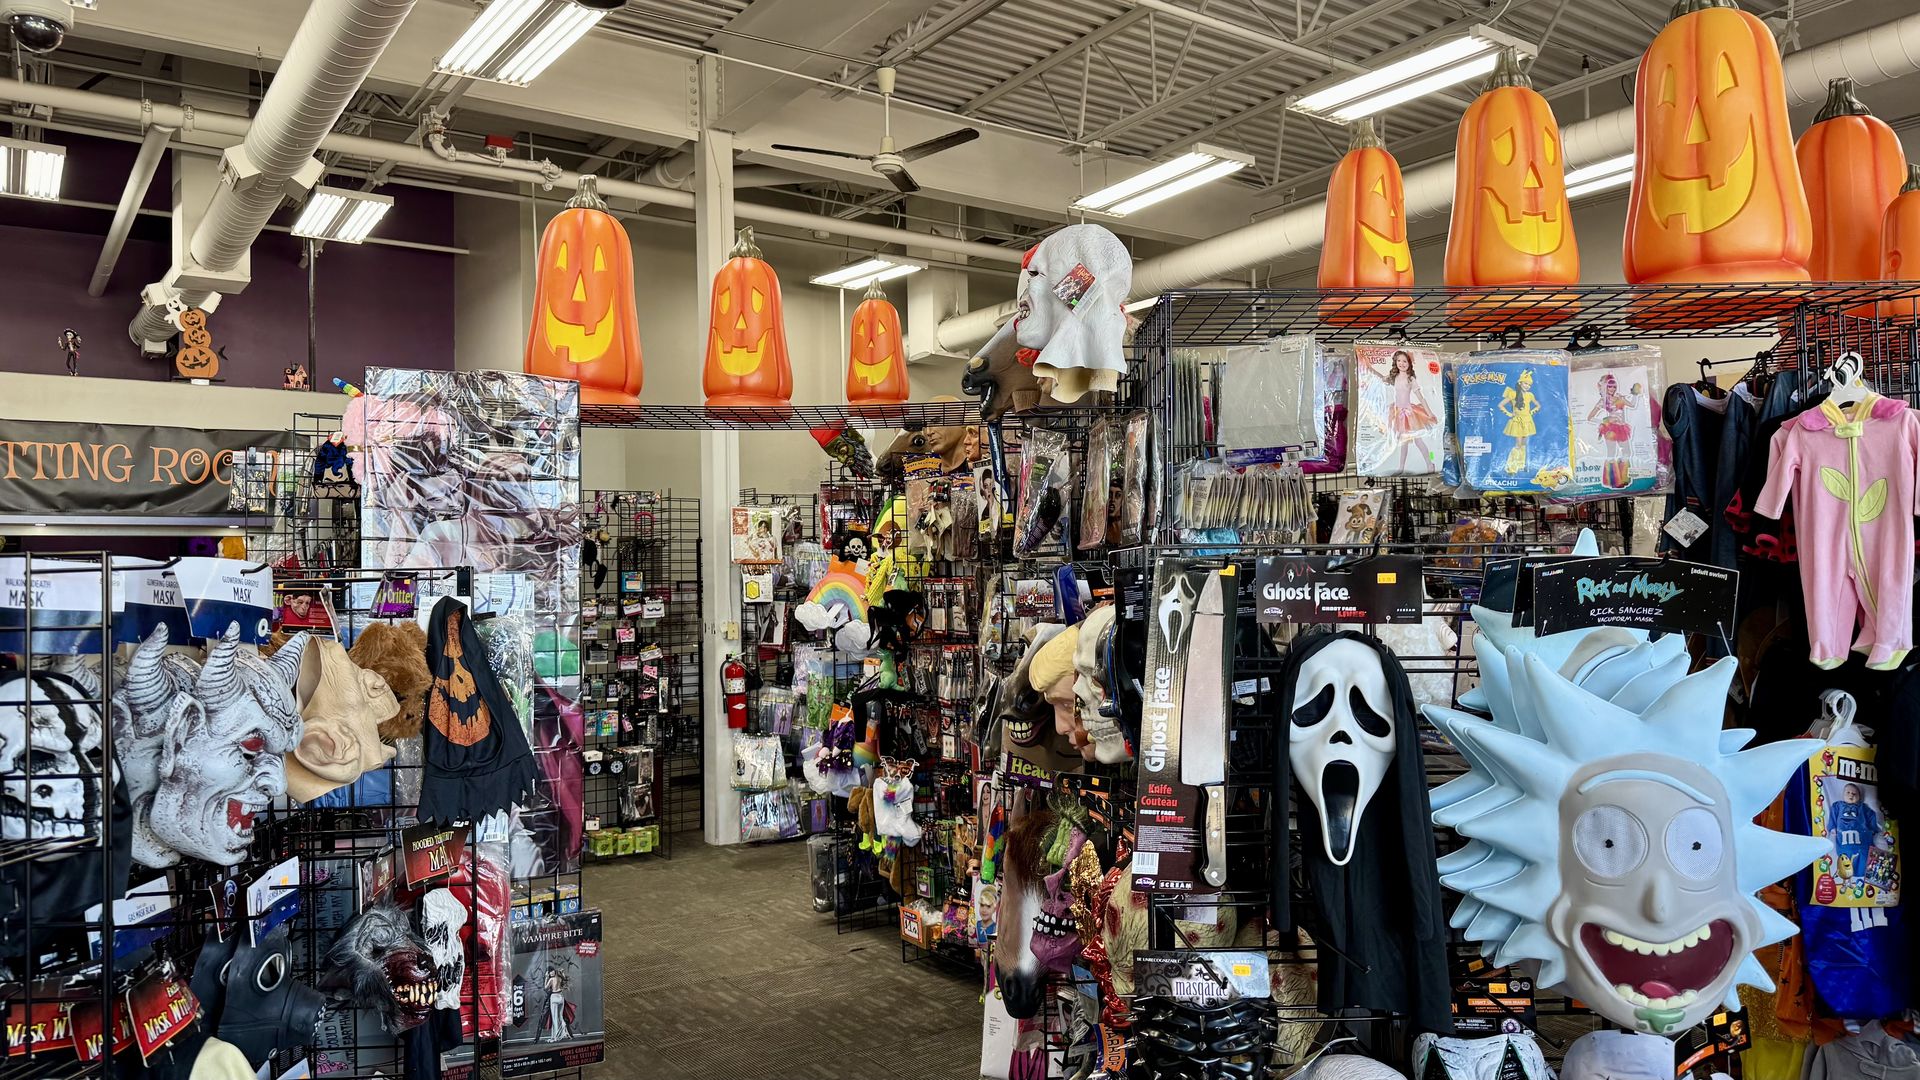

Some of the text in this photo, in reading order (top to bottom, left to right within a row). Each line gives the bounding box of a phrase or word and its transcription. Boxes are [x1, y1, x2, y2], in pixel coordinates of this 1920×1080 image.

[5, 578, 28, 587] WALKIN
[1576, 576, 1613, 605] Rick
[9, 590, 44, 608] MASK
[153, 590, 175, 606] MASK
[233, 586, 252, 603] MASK
[387, 588, 415, 604] Critter
[1262, 581, 1349, 607] Ghost Face
[1590, 606, 1664, 617] RICK SANCHEZ
[1144, 666, 1176, 773] Ghost Face
[1148, 783, 1173, 795] Knife
[1141, 795, 1178, 807] Couteau
[412, 836, 435, 852] HOODED
[1160, 881, 1192, 890] SCREAM
[522, 931, 562, 944] VAMPIRE
[563, 928, 583, 938] BITE
[513, 990, 524, 1007] 6
[143, 1011, 173, 1044] MASK
